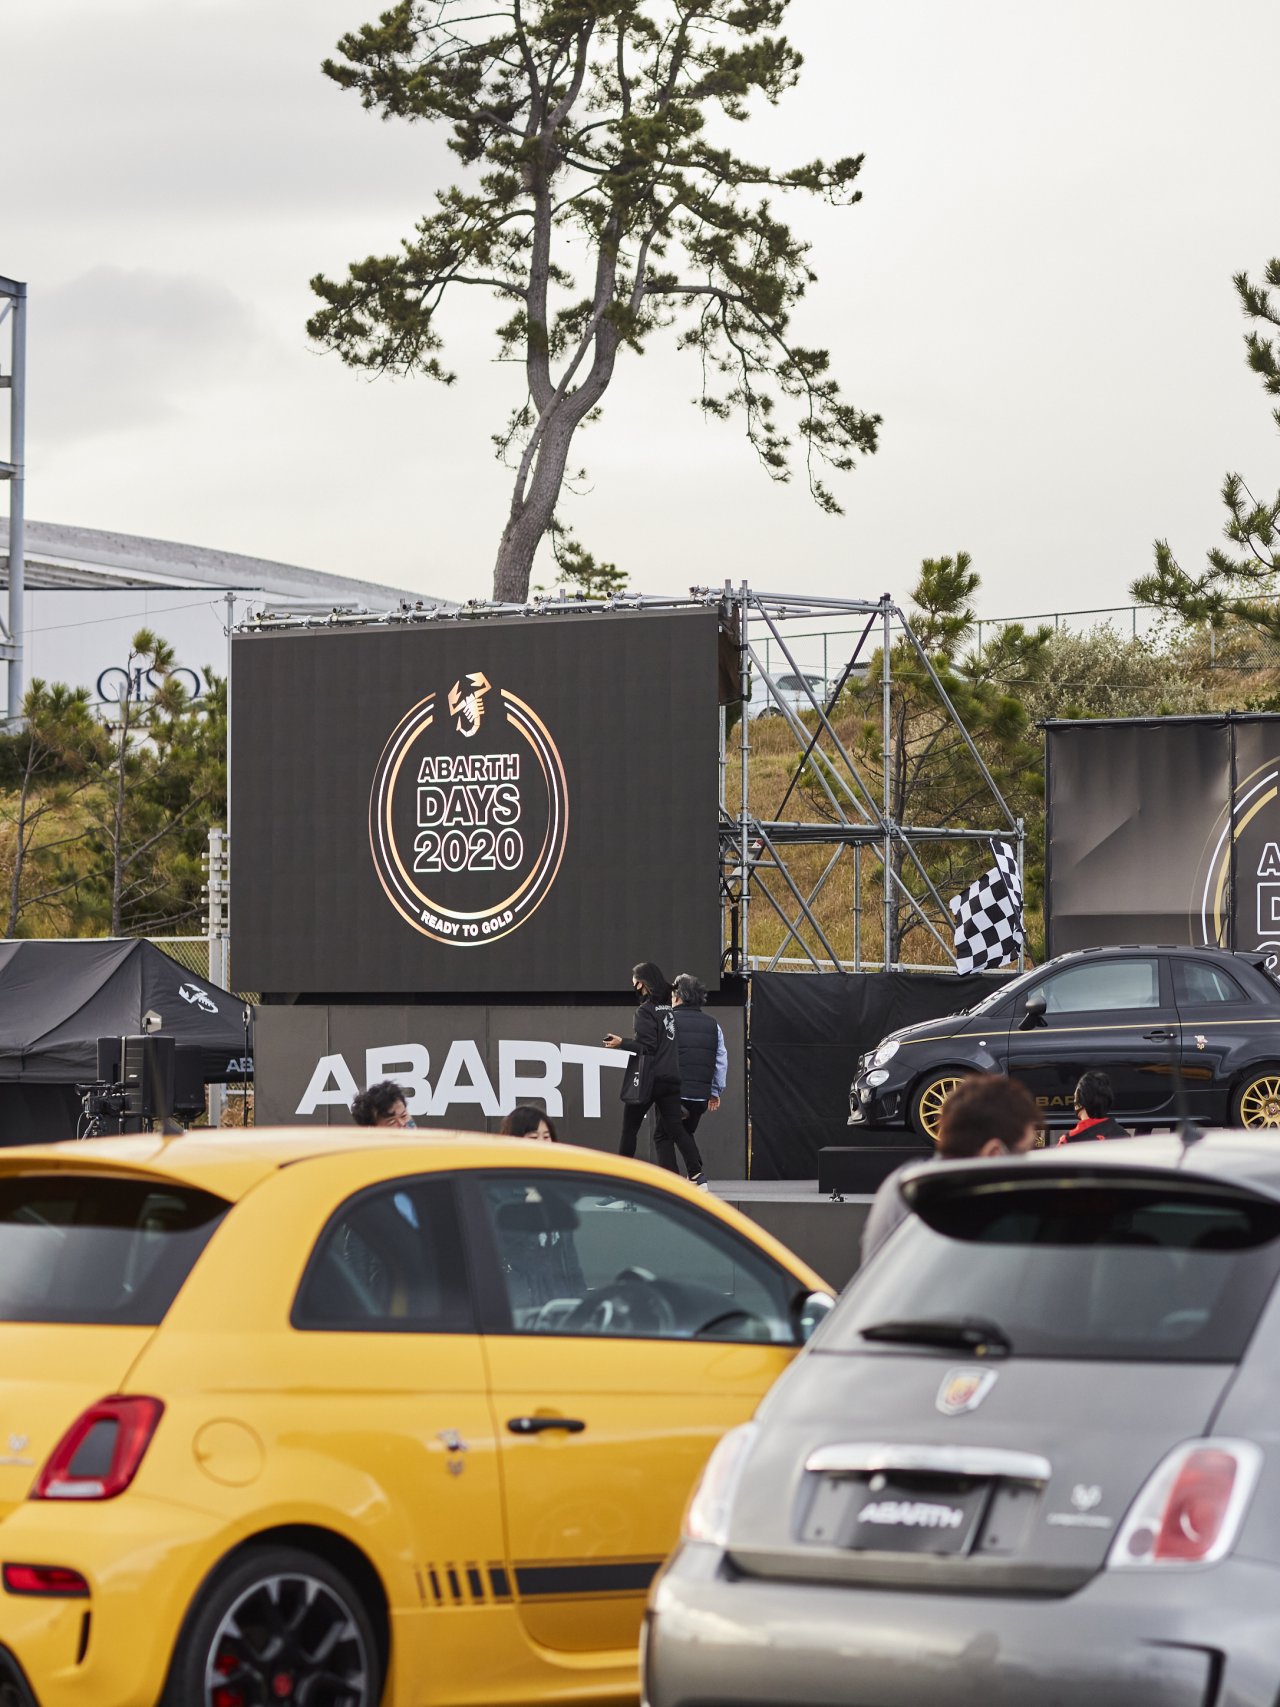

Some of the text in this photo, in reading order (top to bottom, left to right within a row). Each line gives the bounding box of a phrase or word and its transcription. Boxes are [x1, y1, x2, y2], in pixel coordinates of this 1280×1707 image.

[417, 754, 519, 783] ABARTH
[417, 783, 521, 827] DAYS
[414, 828, 524, 872] 2020
[420, 909, 514, 937] READY TO GOLD
[294, 1039, 637, 1118] ABART
[857, 1501, 964, 1528] ABARTH
